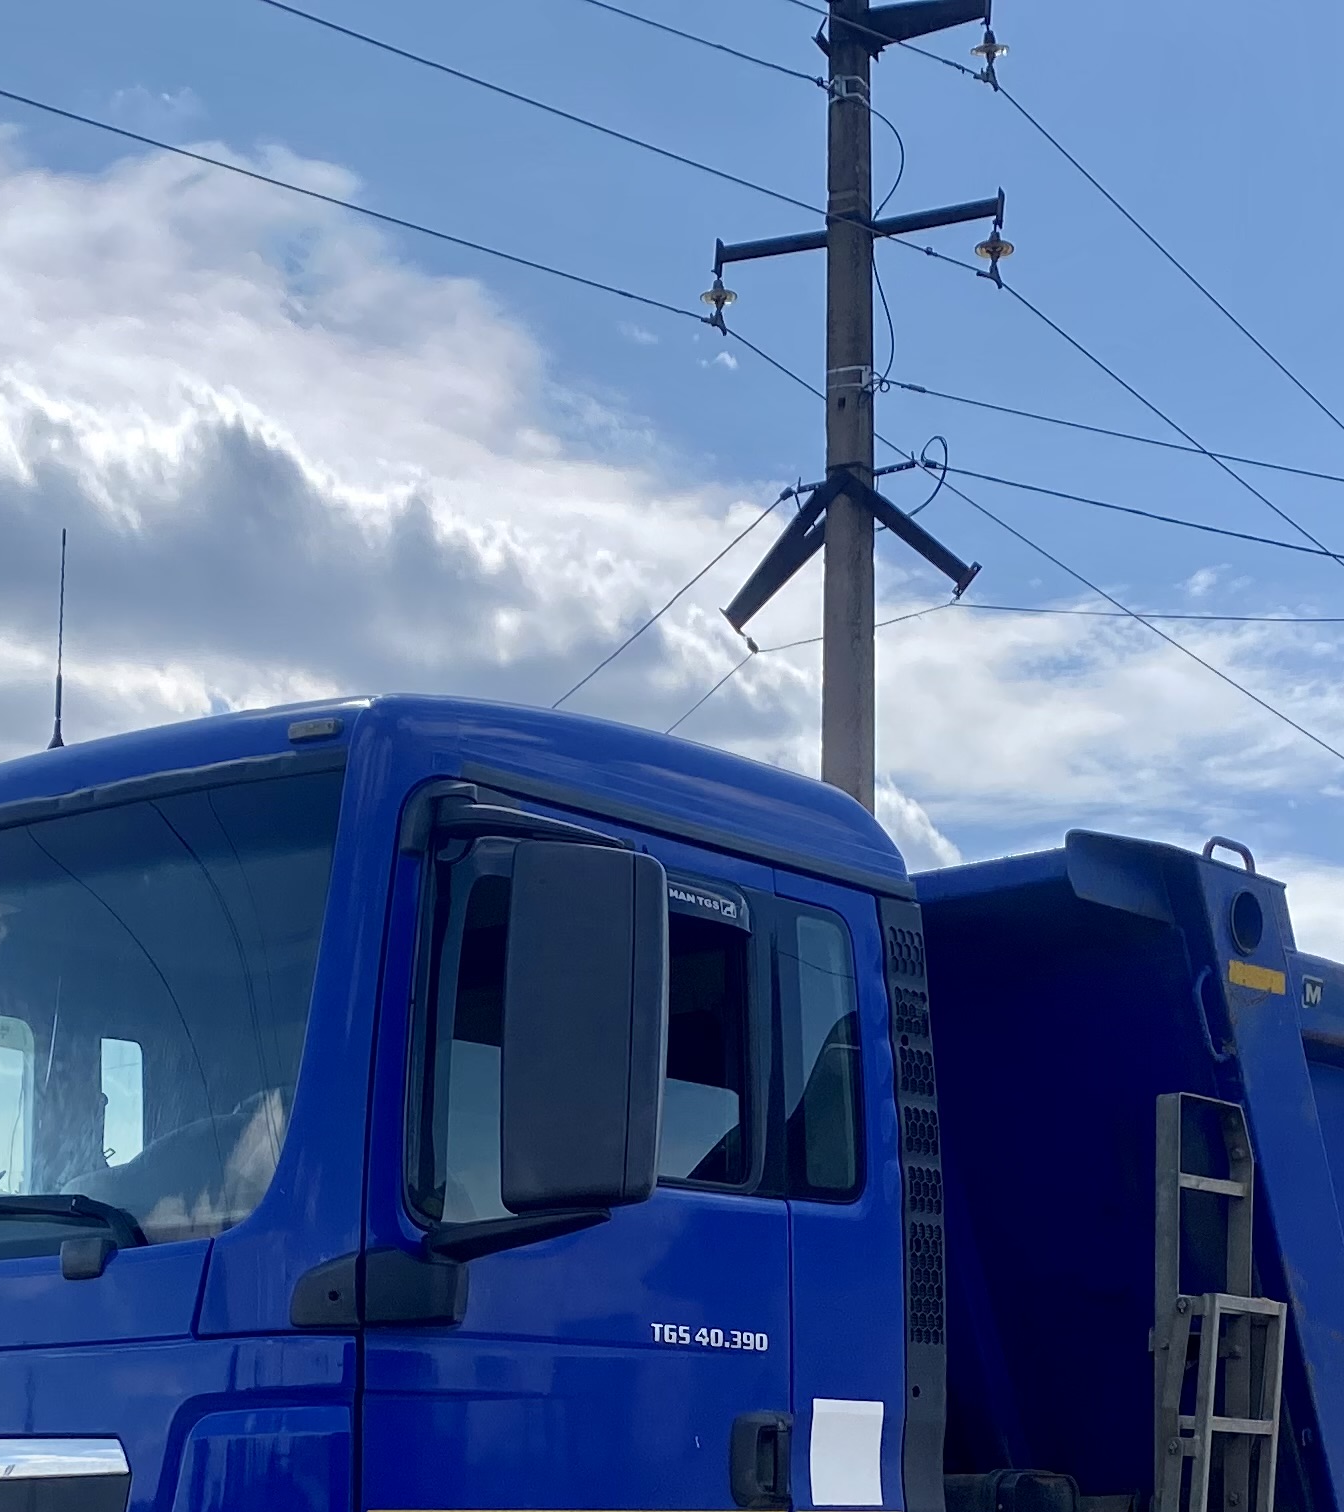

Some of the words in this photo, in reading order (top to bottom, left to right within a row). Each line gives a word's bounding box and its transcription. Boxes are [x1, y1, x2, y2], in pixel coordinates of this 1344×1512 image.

[669, 888, 696, 904] MAN
[697, 896, 720, 911] TGS
[651, 1322, 691, 1345] TGS
[694, 1327, 769, 1352] 40.390
